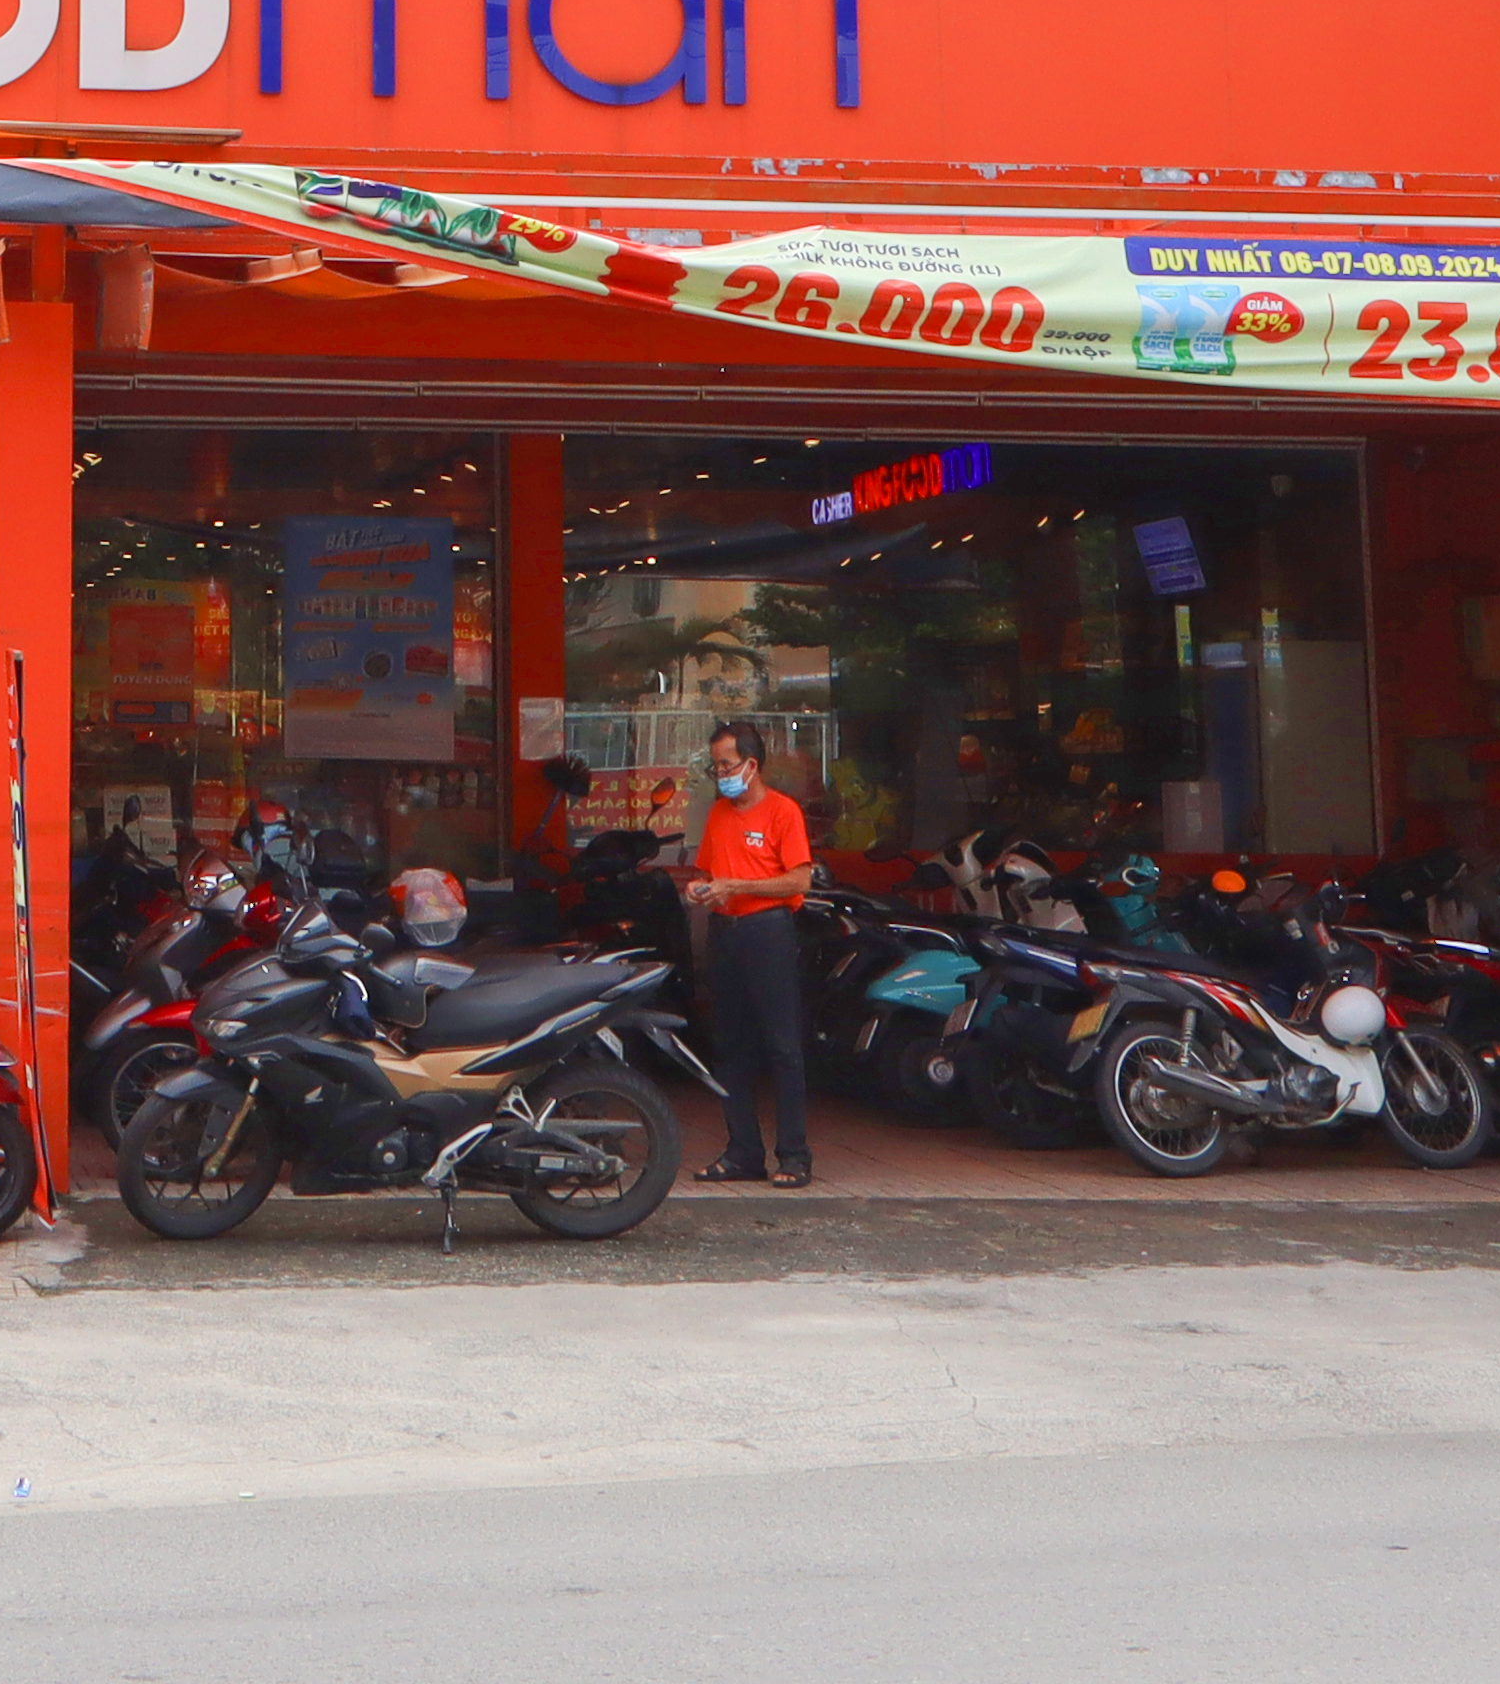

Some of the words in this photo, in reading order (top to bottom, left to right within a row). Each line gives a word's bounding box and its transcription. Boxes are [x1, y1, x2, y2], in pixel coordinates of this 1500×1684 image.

[863, 243, 907, 258] TƯƠI
[1149, 247, 1199, 272] DUY
[1205, 242, 1273, 273] NHẤT
[830, 252, 894, 272] KHÔNG
[969, 263, 1001, 277] (1L)
[714, 264, 1046, 353] 26.000
[1246, 297, 1284, 312] GIẢM
[1236, 313, 1293, 334] 33%
